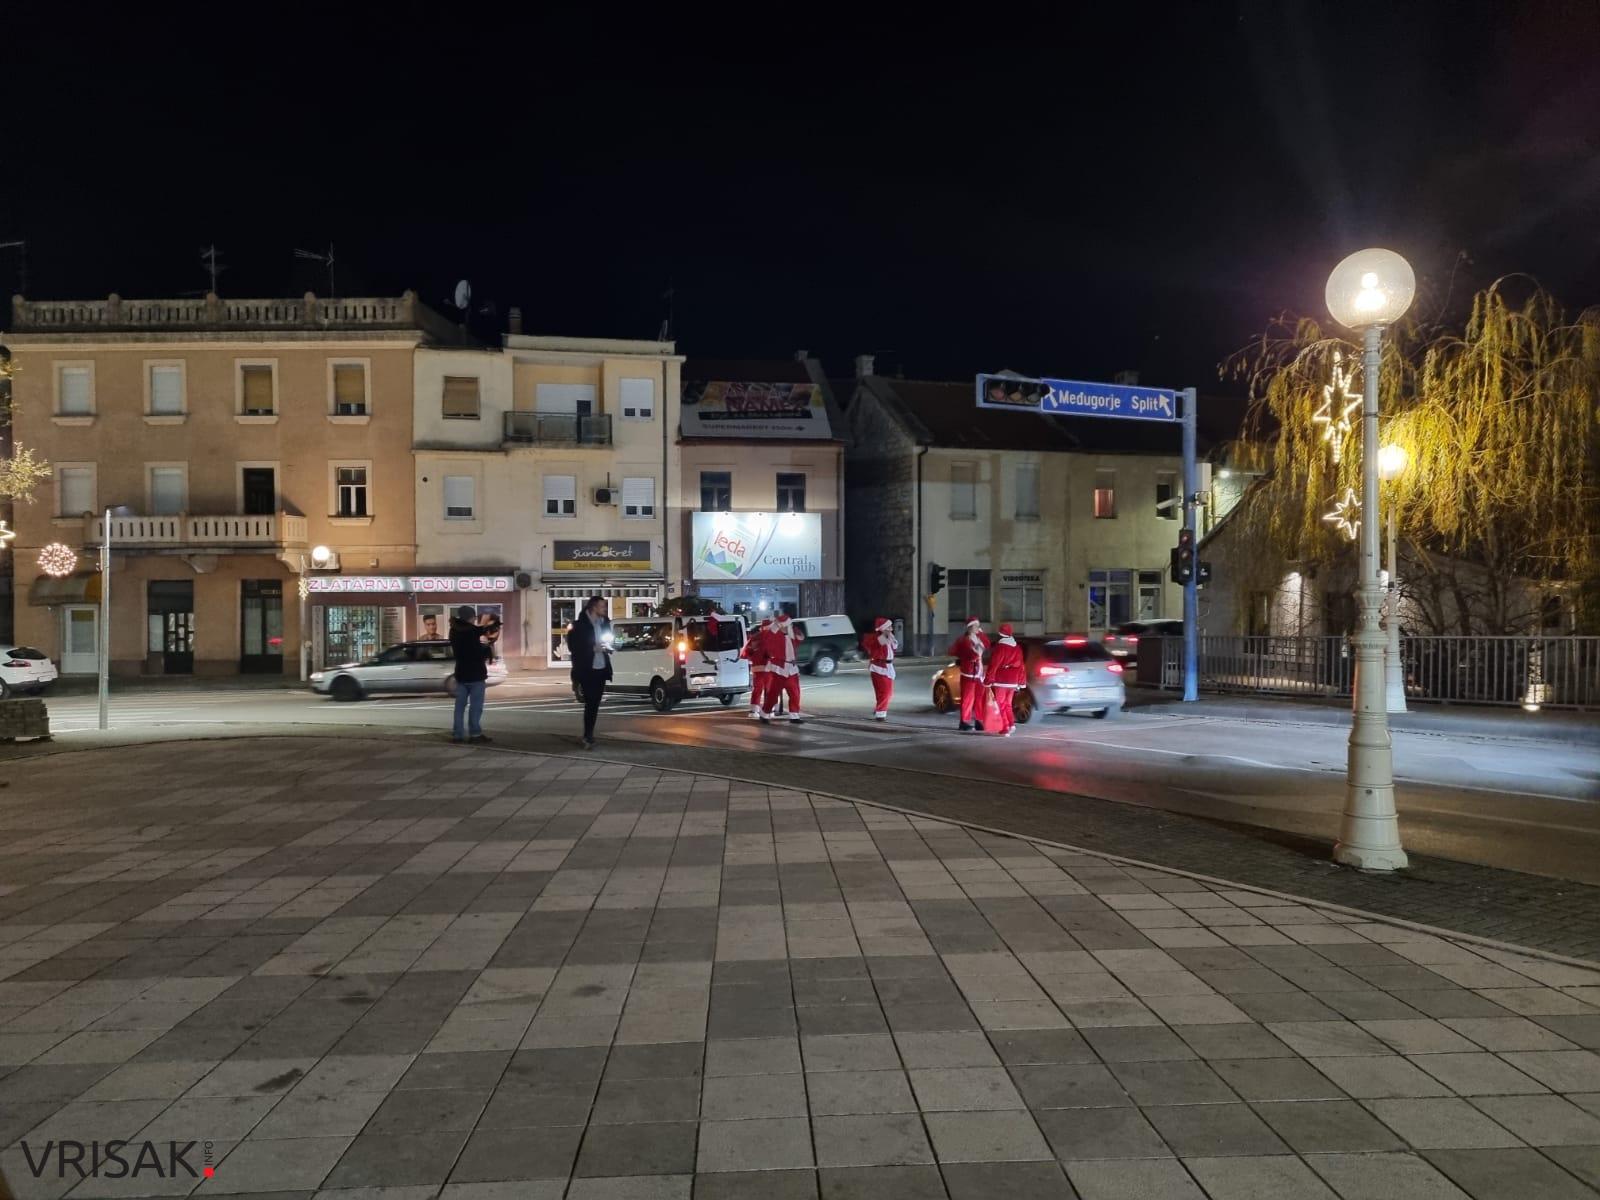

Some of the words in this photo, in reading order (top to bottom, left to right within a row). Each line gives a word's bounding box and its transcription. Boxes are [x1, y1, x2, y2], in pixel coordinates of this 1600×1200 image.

[1131, 395, 1158, 413] Split
[713, 530, 747, 559] leda
[763, 554, 808, 565] Central
[793, 562, 816, 575] pub
[307, 577, 402, 592] ZLATARNA
[408, 577, 455, 591] TONI
[457, 577, 508, 592] GOLD
